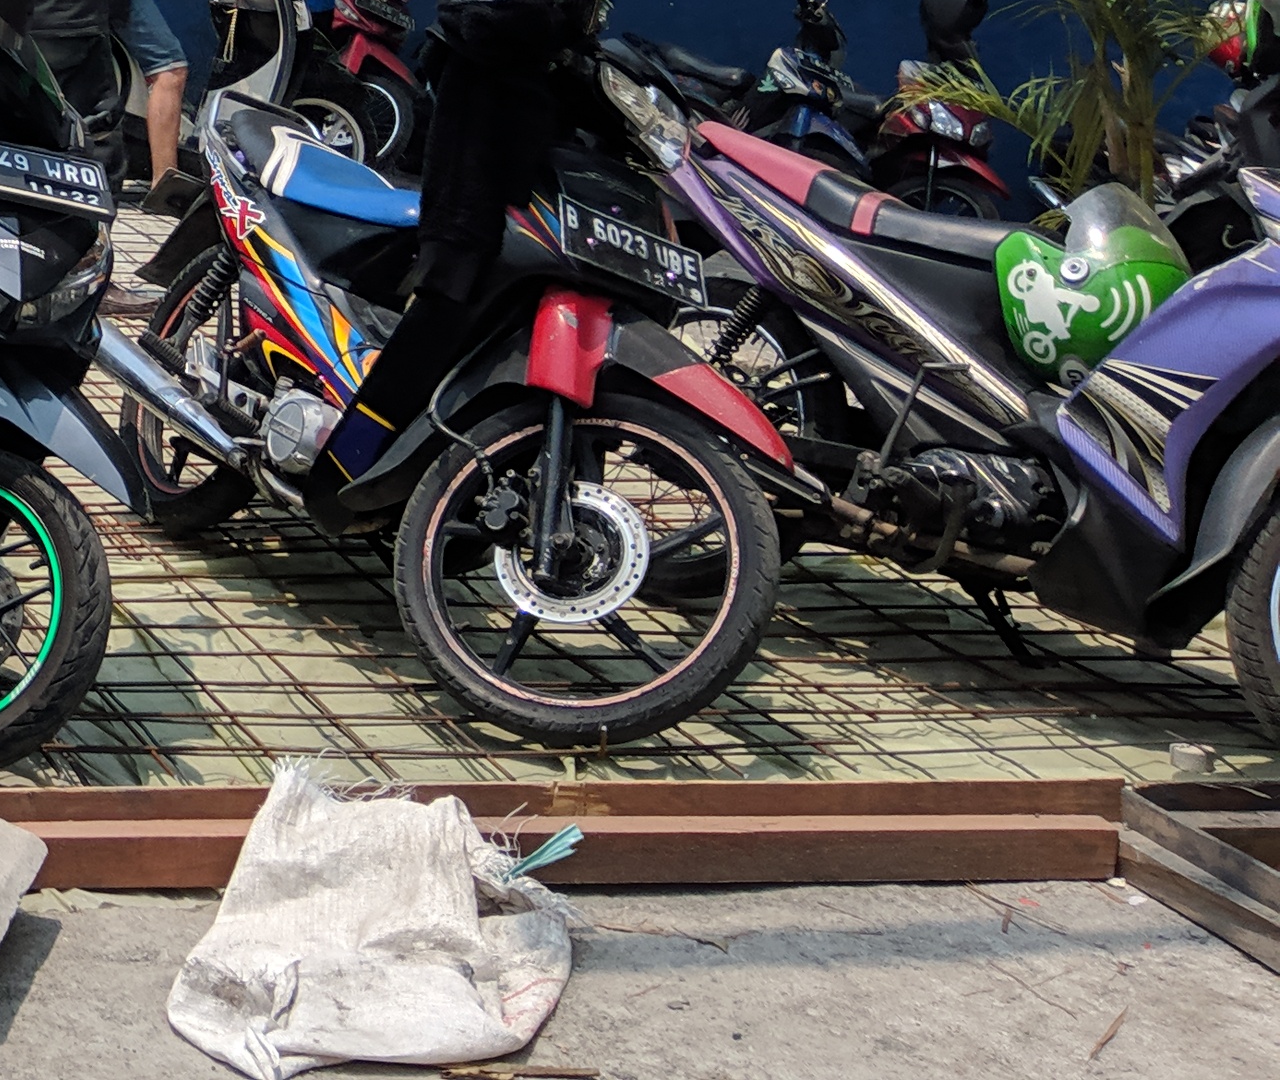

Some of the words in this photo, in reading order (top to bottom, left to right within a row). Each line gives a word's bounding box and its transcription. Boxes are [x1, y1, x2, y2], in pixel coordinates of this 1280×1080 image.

[566, 203, 579, 230] B
[593, 217, 650, 261] 6023
[653, 241, 698, 283] UBE
[243, 297, 274, 324] ASTREA
